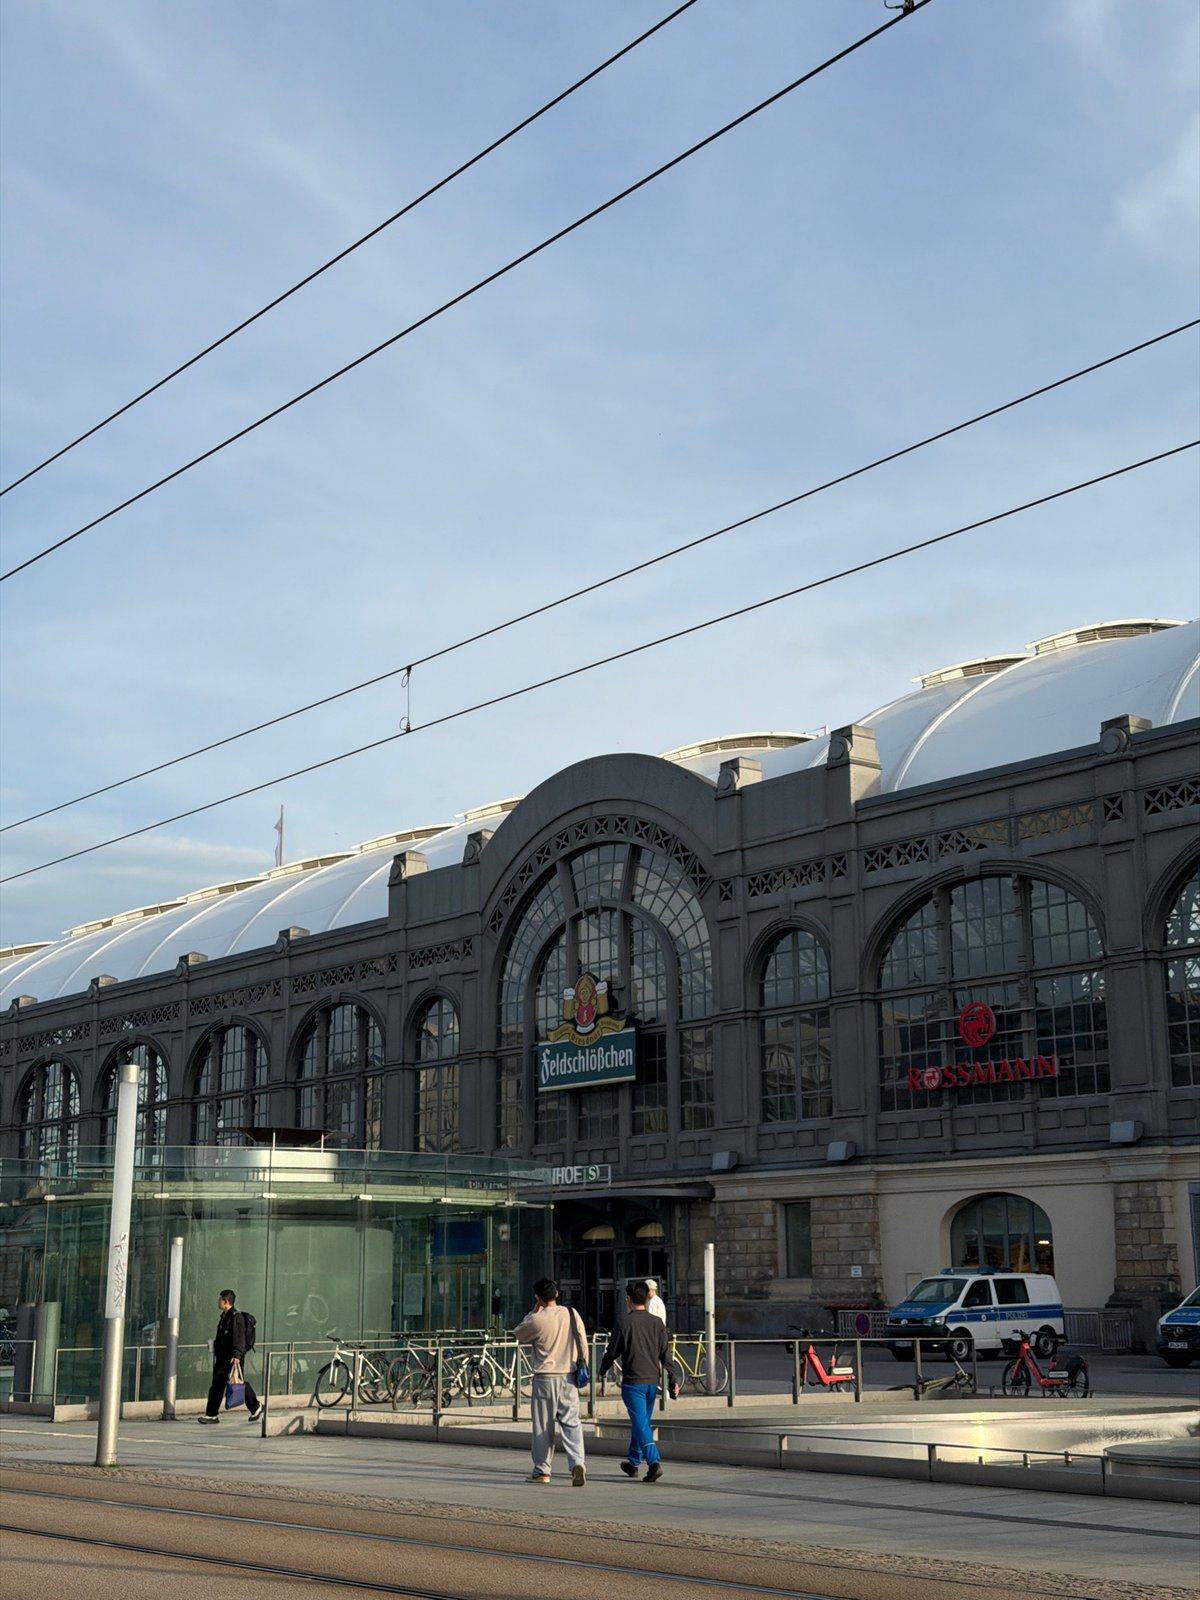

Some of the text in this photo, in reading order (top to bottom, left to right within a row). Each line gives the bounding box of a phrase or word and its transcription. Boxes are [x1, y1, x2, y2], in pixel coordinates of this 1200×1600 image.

[540, 1045, 633, 1085] Feldschlößchen
[907, 1055, 1057, 1091] ROSSMANN
[1006, 1311, 1028, 1320] POLIZEI
